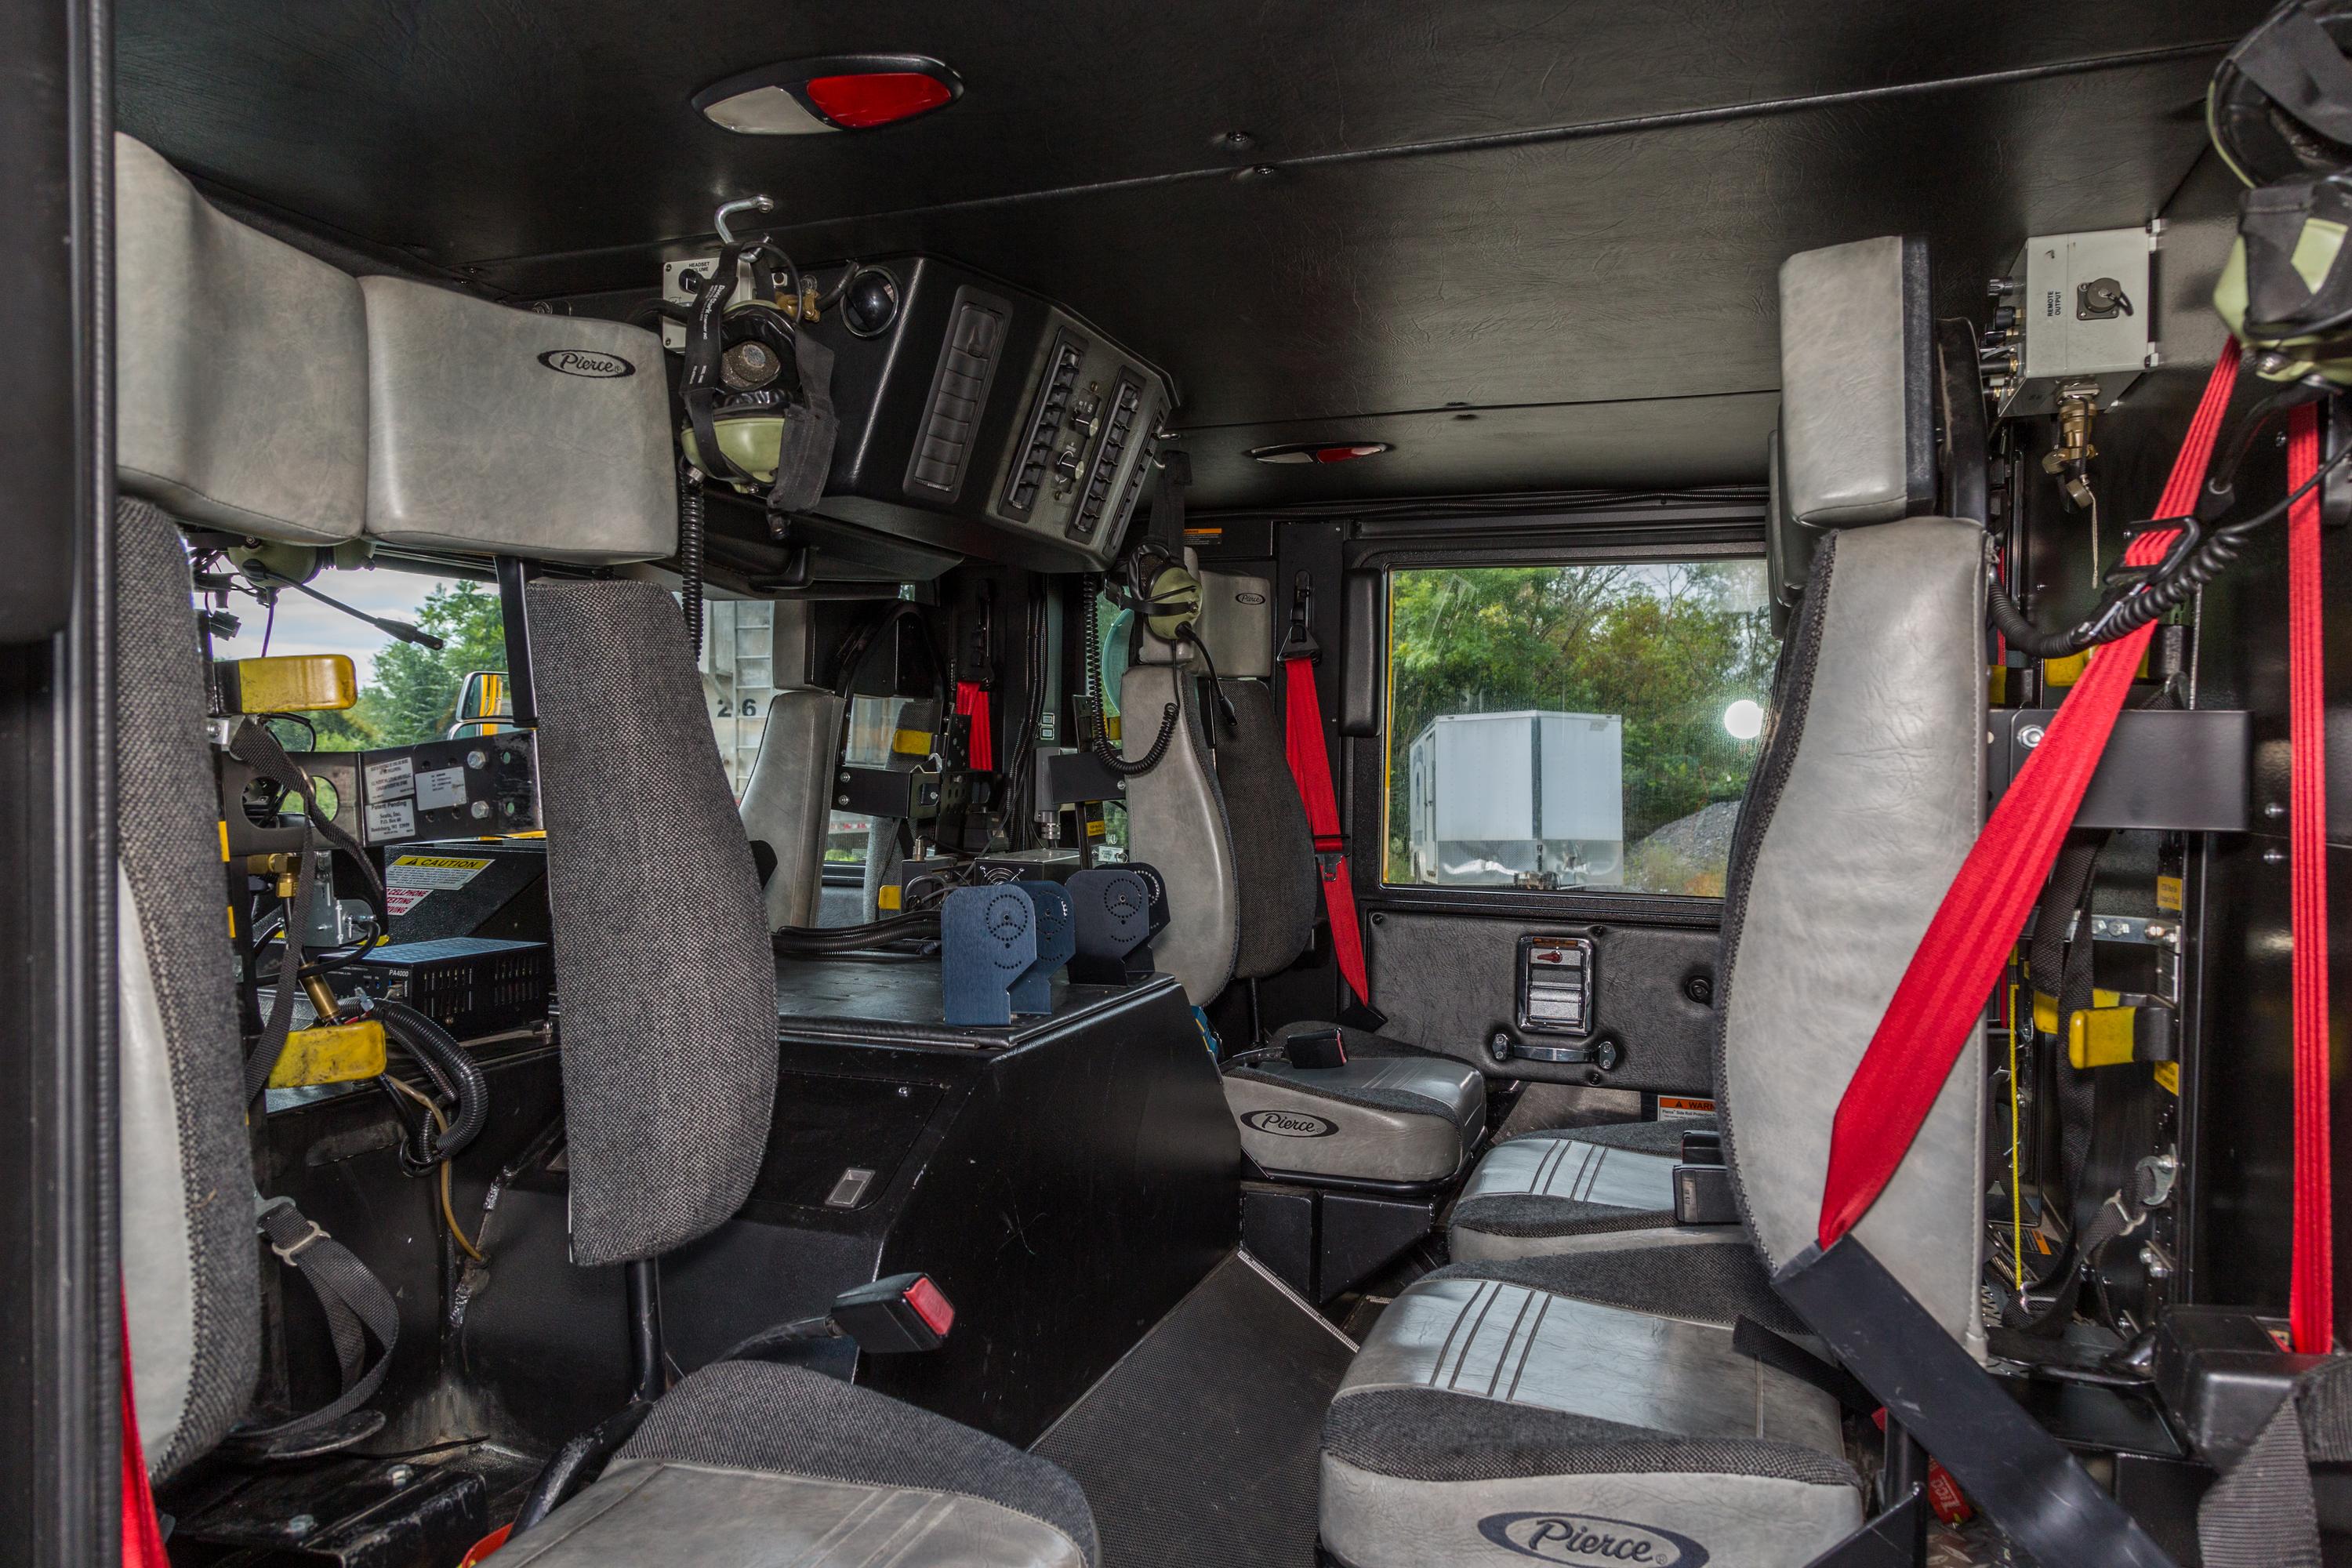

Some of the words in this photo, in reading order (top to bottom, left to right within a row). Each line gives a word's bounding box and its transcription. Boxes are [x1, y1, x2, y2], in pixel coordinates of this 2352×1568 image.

[560, 353, 614, 372] Pierce
[420, 858, 477, 868] CAUTION
[388, 888, 429, 897] CELLPHONE
[1689, 1102, 1716, 1110] WARN
[1261, 1113, 1315, 1132] Pierce
[1529, 1518, 1652, 1563] Pierce
